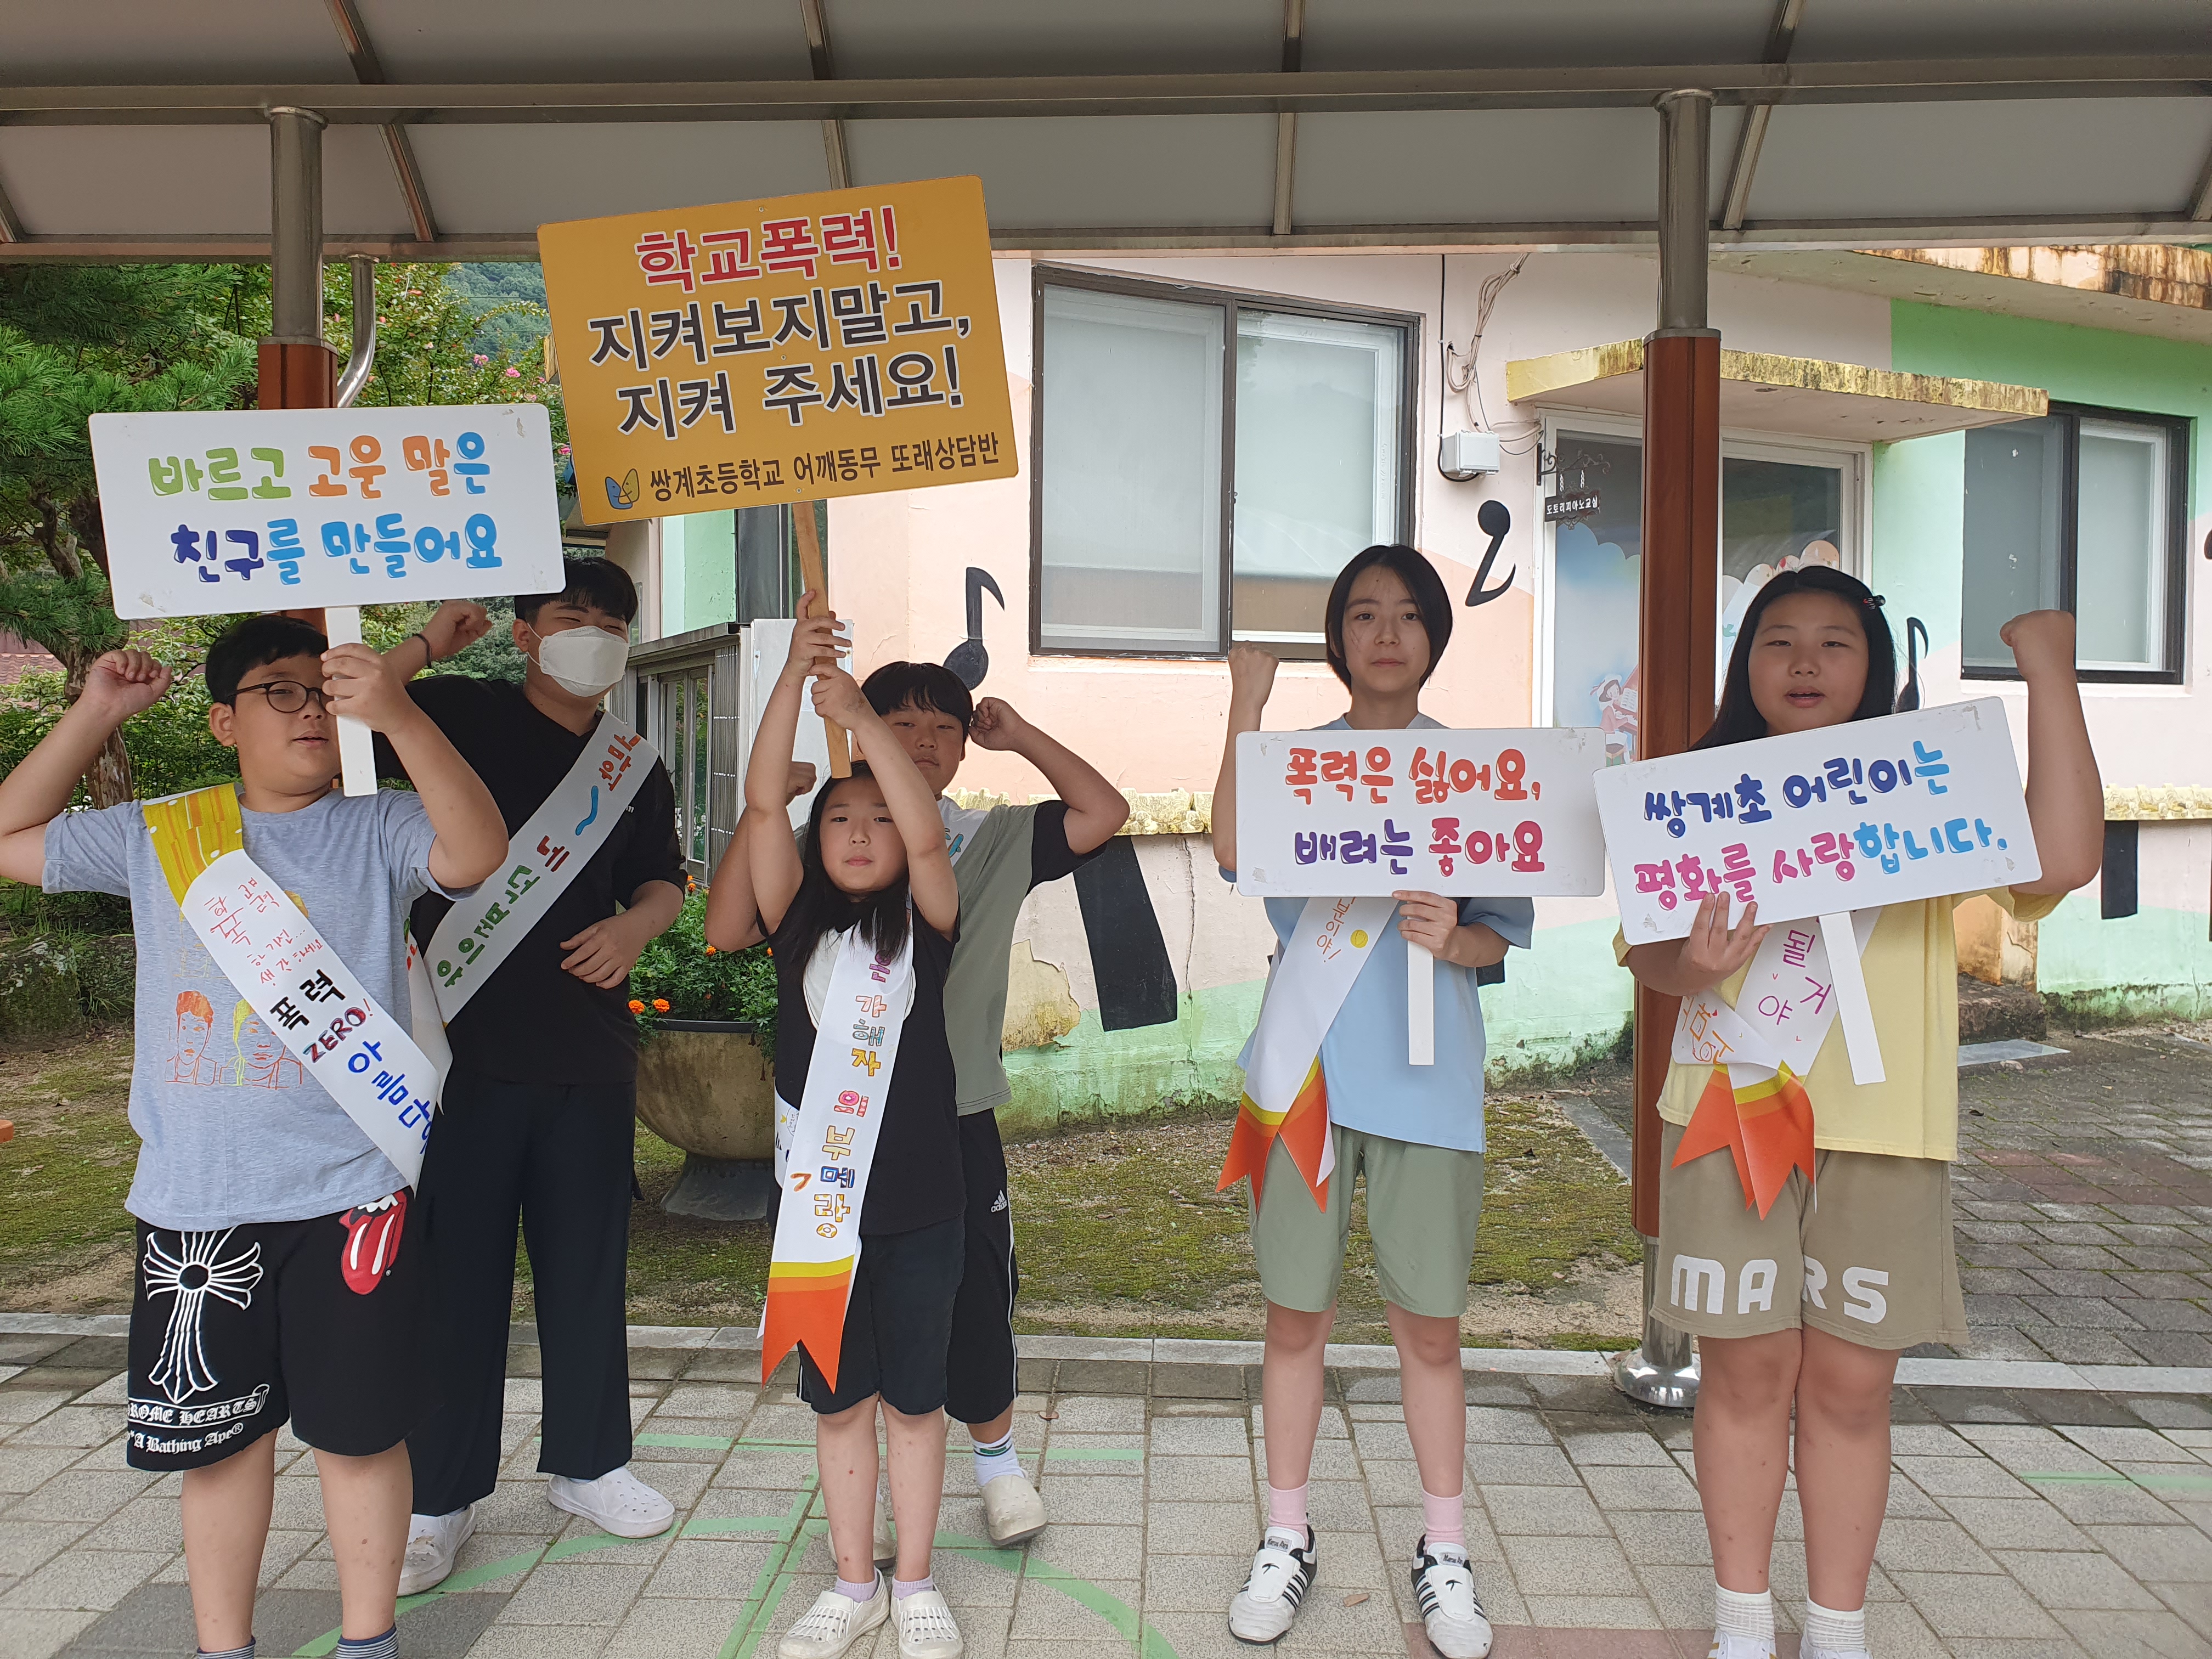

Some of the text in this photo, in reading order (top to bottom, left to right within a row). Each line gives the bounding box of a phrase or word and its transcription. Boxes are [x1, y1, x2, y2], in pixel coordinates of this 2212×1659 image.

[635, 205, 902, 292] 학교폭력!
[589, 279, 972, 371] 지켜보지말고,
[617, 345, 963, 439] 지켜 주세요!
[148, 431, 490, 500] 바르고 고운 말은
[650, 432, 999, 501] 쌍계초등학교 어깨동무 또래상담반
[170, 512, 503, 585] 친구를 만들어요
[1285, 746, 1541, 805] 폭력은 싫어요,
[1644, 740, 1950, 838] 쌍계초 어린이는
[1295, 817, 1545, 877] 배려는 좋아요
[1634, 817, 2008, 911] 평화를 사랑합니다.
[302, 998, 374, 1063] ZERO!
[1671, 1254, 1889, 1324] MARS
[128, 1398, 258, 1426] ROME HEARTS
[146, 1435, 202, 1454] Bathing
